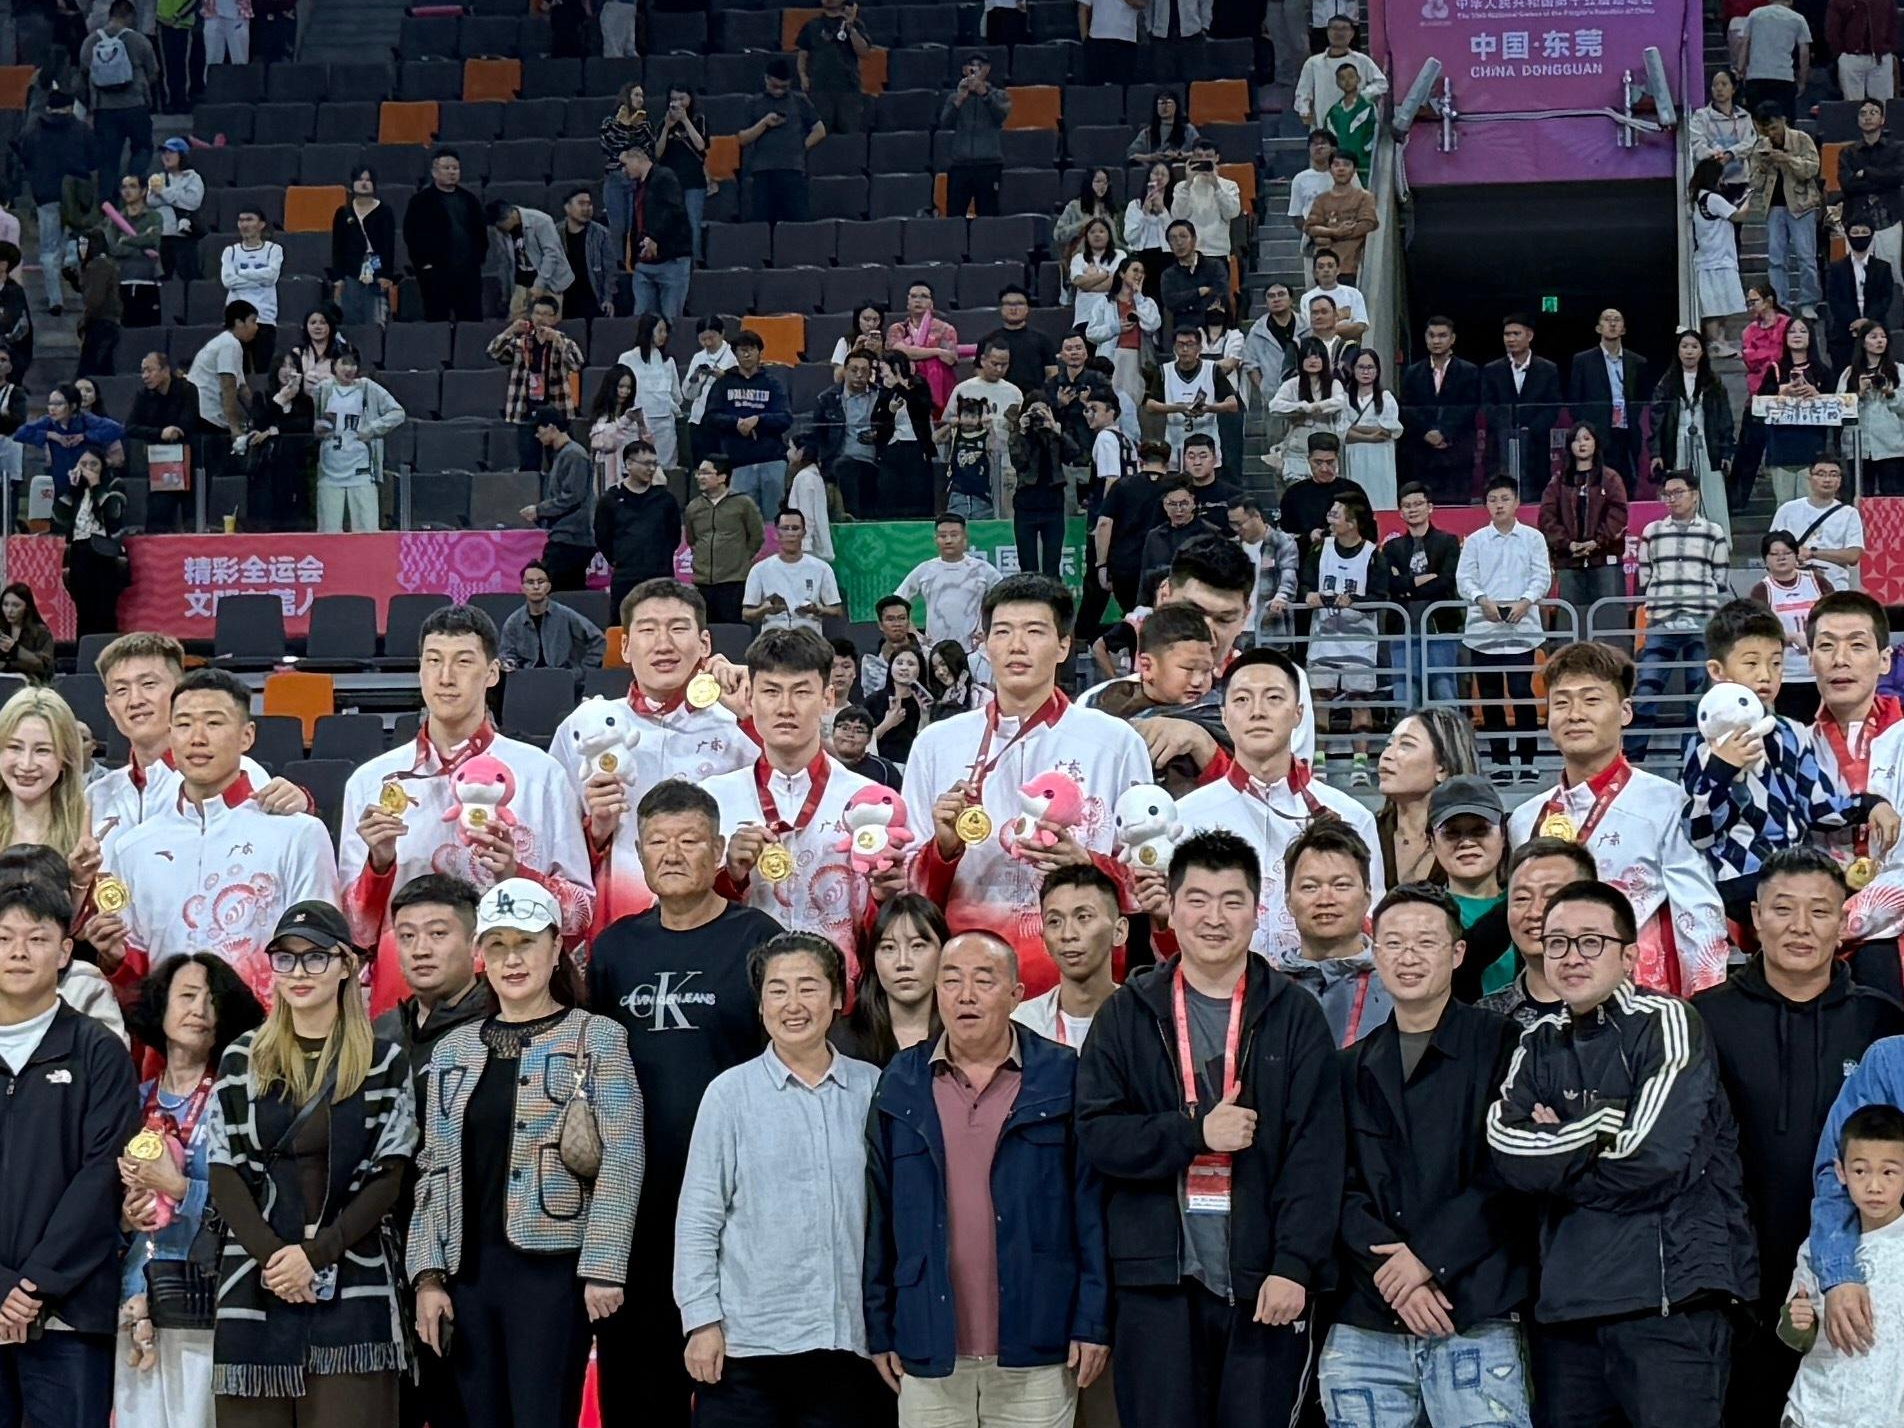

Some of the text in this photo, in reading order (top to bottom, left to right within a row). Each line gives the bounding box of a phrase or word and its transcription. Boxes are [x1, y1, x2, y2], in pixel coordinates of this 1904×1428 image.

[1470, 29, 1603, 61] 中国·东莞
[1470, 63, 1603, 78] CHINA DONGGUAN
[183, 555, 325, 586] 精彩全运会
